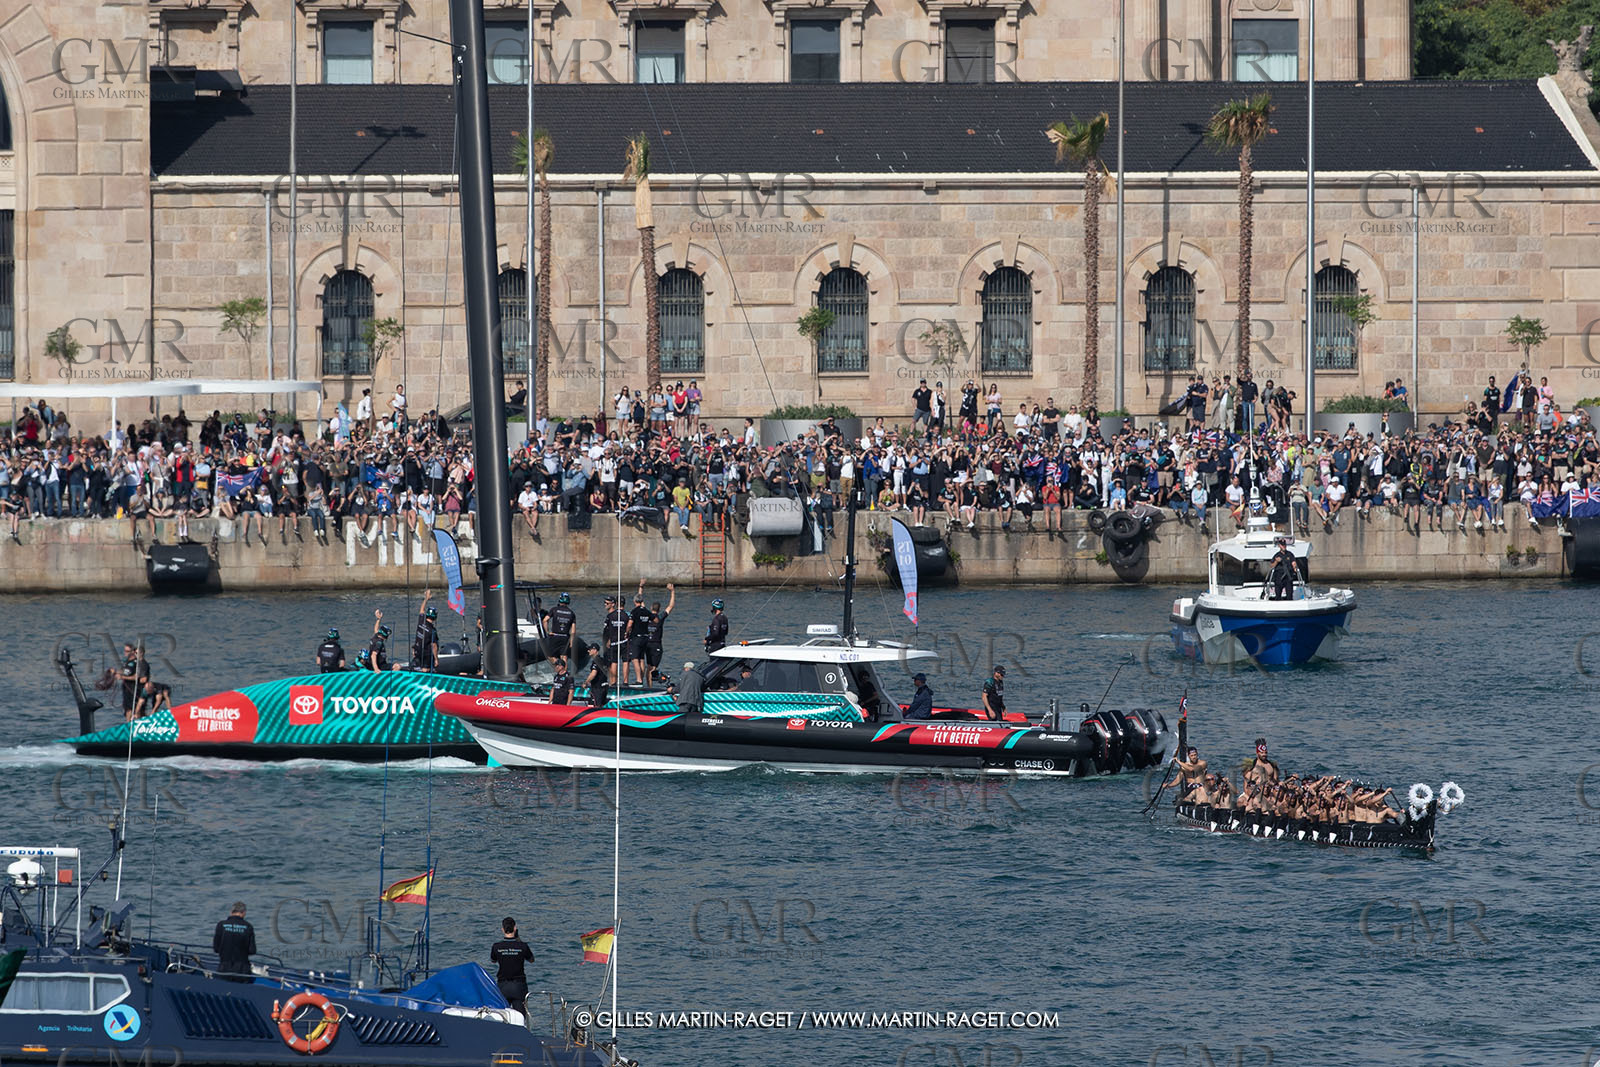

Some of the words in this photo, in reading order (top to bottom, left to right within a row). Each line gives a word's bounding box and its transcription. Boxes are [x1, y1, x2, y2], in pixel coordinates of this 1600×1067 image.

[331, 696, 415, 715] TOYOTA
[476, 697, 510, 710] OMEGA
[190, 705, 240, 720] Emirates
[810, 719, 853, 729] TOYOTA
[933, 731, 948, 744] FLY
[949, 731, 981, 745] BETTER
[1014, 759, 1043, 768] CHASE
